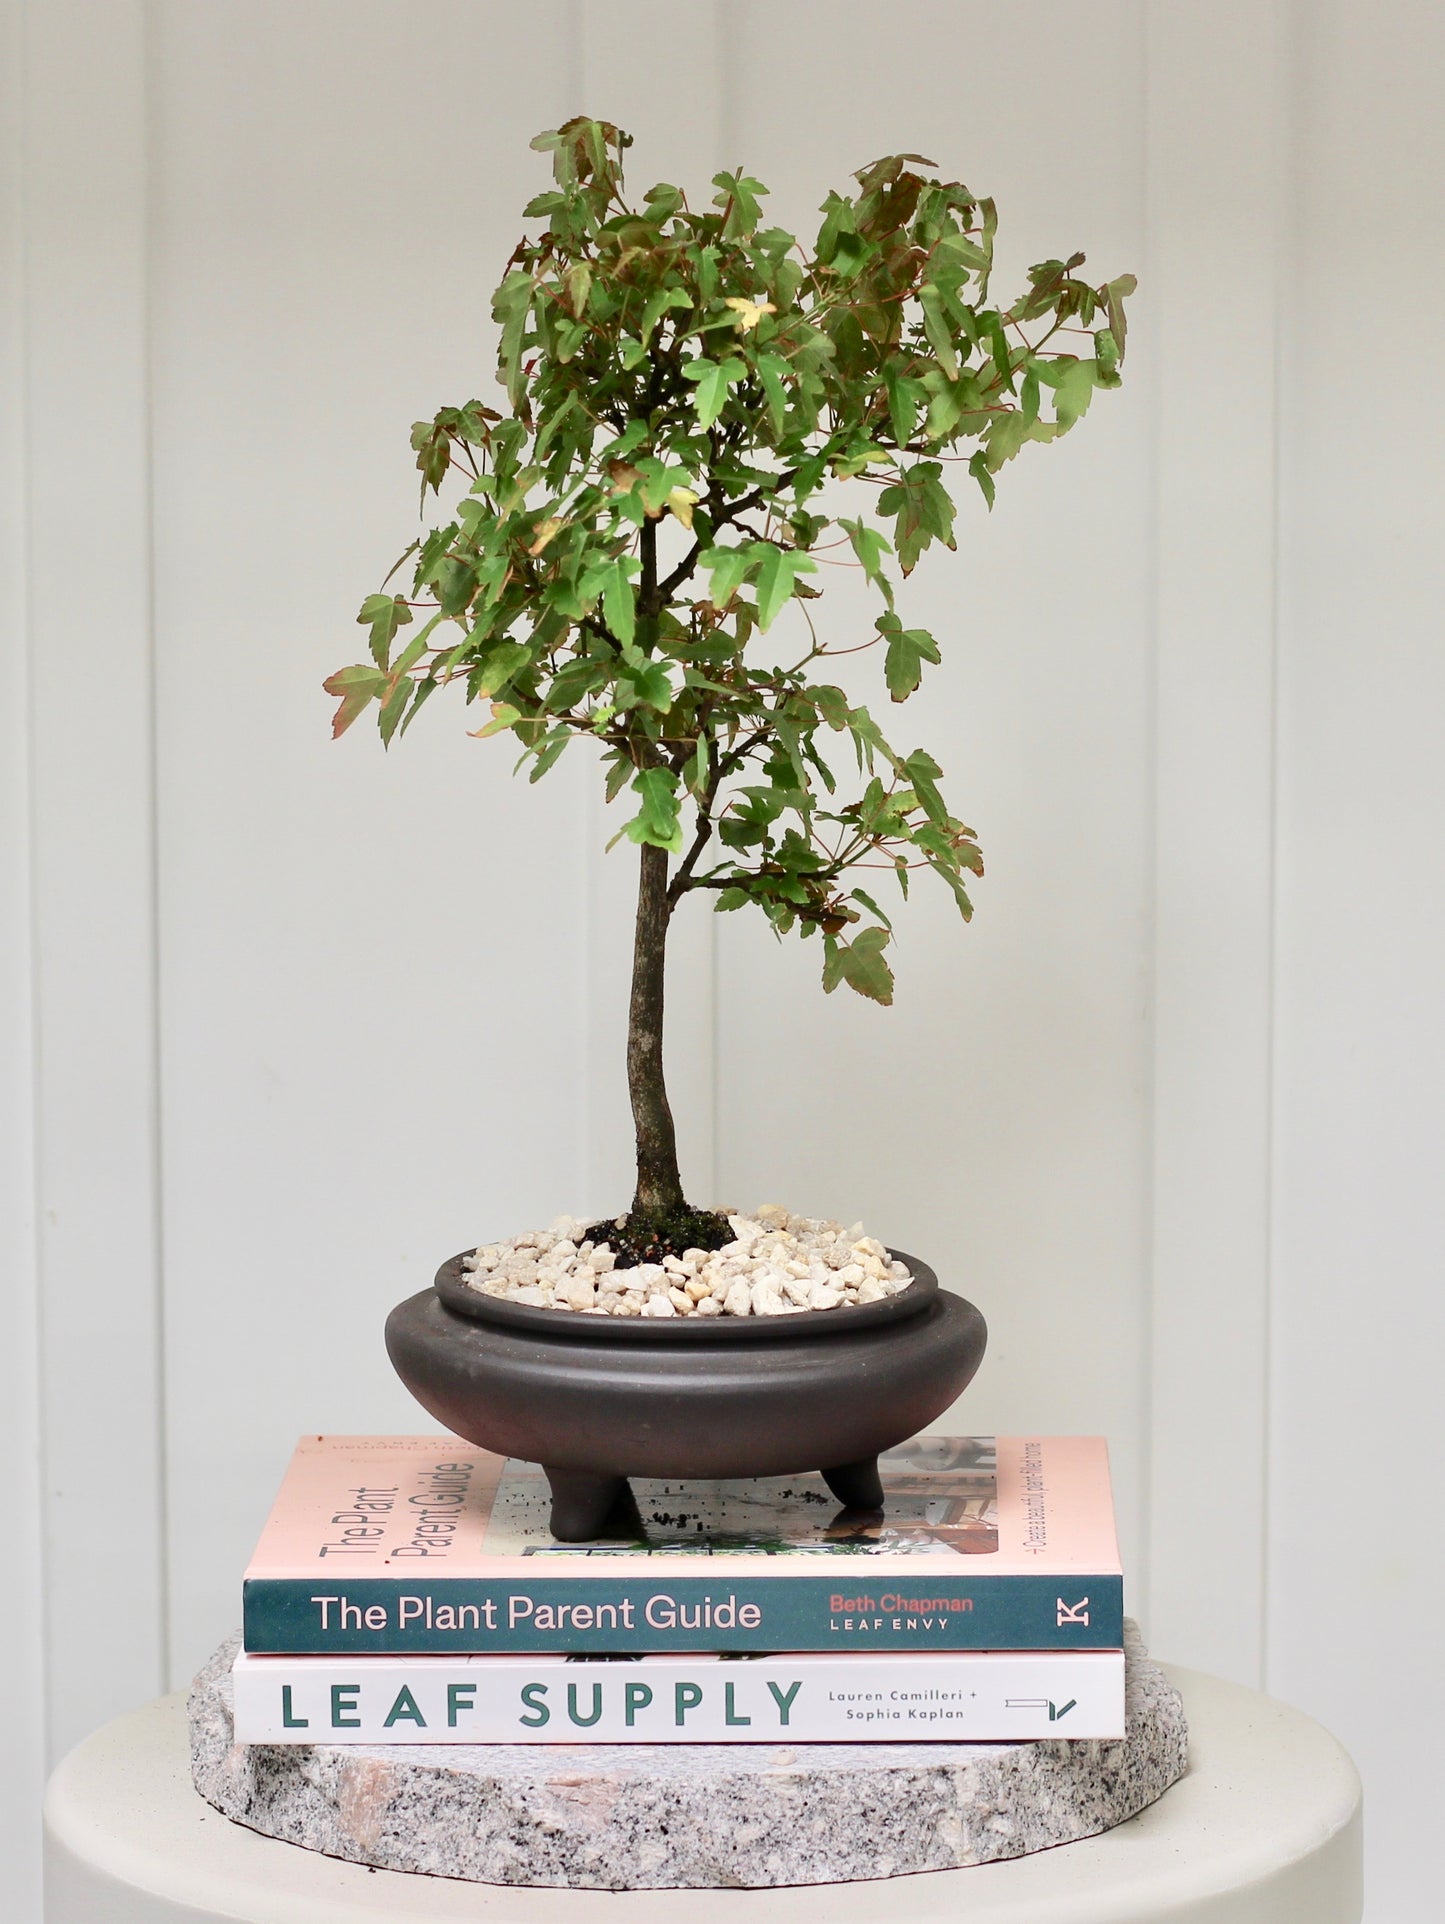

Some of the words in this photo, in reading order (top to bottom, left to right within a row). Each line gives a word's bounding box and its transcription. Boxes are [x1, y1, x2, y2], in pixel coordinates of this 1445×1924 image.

[1019, 1442, 1041, 1459] home
[408, 1463, 475, 1506] Guide
[331, 1487, 399, 1524] Plant
[319, 1528, 385, 1557] The
[391, 1509, 462, 1557] Parent
[311, 1596, 388, 1630] The
[398, 1596, 498, 1630] Plant
[508, 1596, 635, 1630] Parent
[645, 1595, 762, 1630] Guide
[830, 1594, 876, 1613] Beth
[880, 1594, 973, 1615] Chapman
[1056, 1596, 1090, 1627] K
[830, 1618, 884, 1631] LEAF
[892, 1618, 949, 1630] ENVY
[282, 1684, 478, 1728] LEAF
[519, 1681, 803, 1727] SUPPLY
[829, 1690, 883, 1701] Lauren
[890, 1689, 963, 1701] Camilleri
[846, 1708, 901, 1722] Sophia
[908, 1708, 964, 1721] Kaplan
